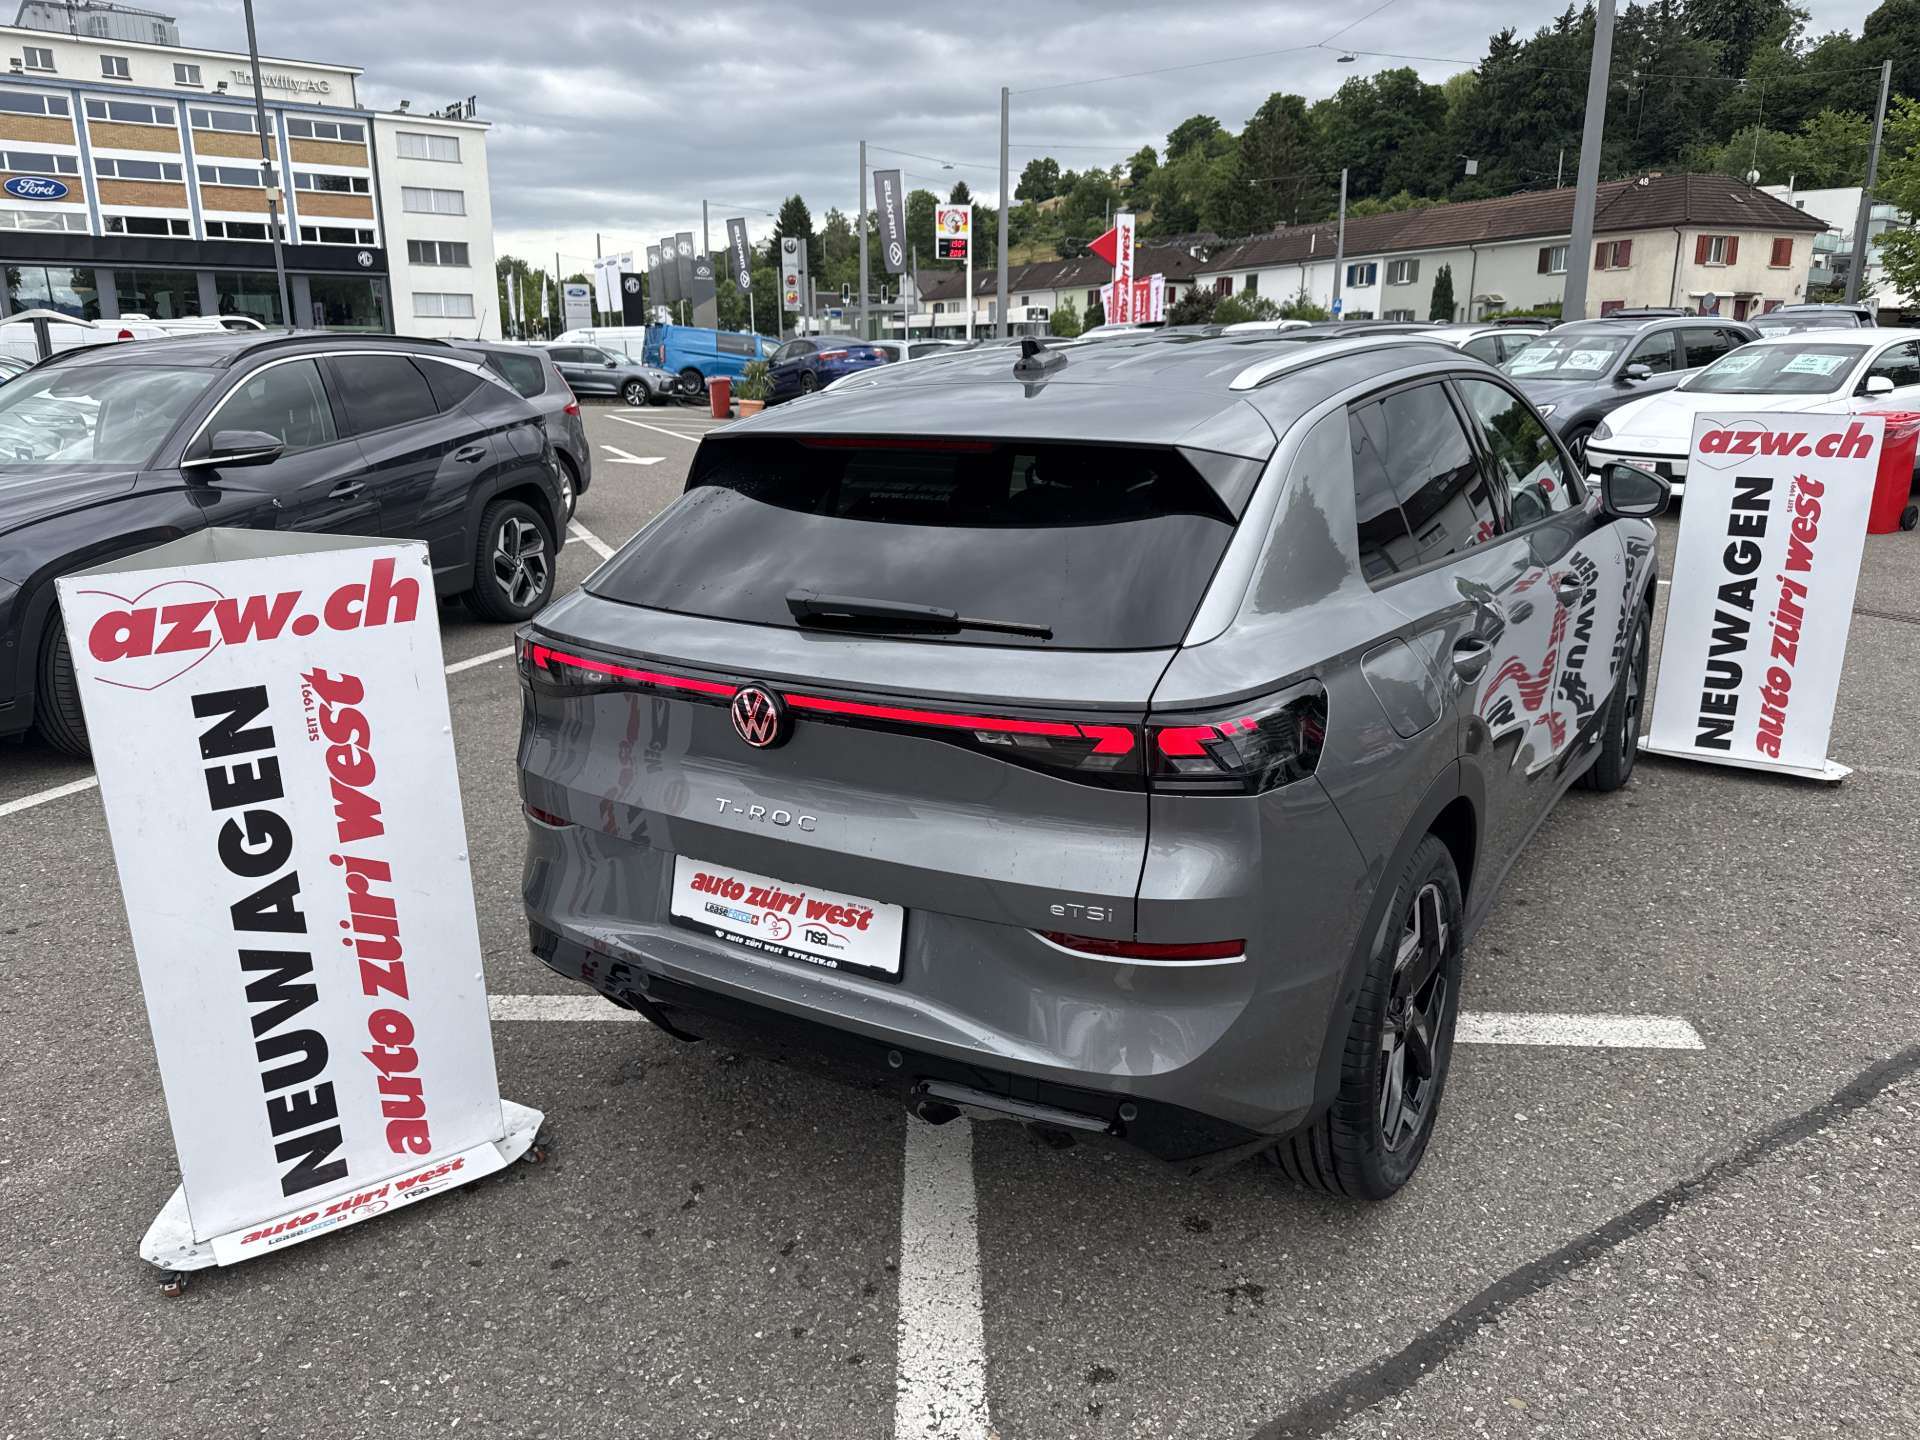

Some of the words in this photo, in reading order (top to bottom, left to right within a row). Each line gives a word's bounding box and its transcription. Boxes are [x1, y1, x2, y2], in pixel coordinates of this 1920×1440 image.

[306, 79, 331, 95] AG
[17, 179, 56, 195] Ford
[1699, 422, 1874, 459] azw.ch
[1785, 473, 1826, 573] west
[88, 557, 420, 663] azw.ch
[1694, 476, 1774, 751] NEUWAGEN
[1767, 574, 1809, 668] züri
[301, 683, 316, 713] 1991
[1756, 665, 1793, 760] auto
[300, 667, 385, 844] west
[307, 717, 321, 742] SEIT
[716, 797, 818, 832] T-ROC
[329, 853, 408, 1000] züri
[690, 872, 745, 901] auto
[744, 884, 806, 915] züri
[805, 899, 874, 931] west
[1050, 904, 1113, 922] eTSi
[191, 684, 349, 1198] NEUWAGEN
[726, 933, 744, 944] auto
[764, 943, 783, 954] west
[805, 929, 828, 946] nsa
[360, 1009, 433, 1155] auto
[240, 1212, 319, 1245] auto
[323, 1184, 390, 1217] züri
[395, 1157, 465, 1191] west
[404, 1186, 430, 1200] nsa
